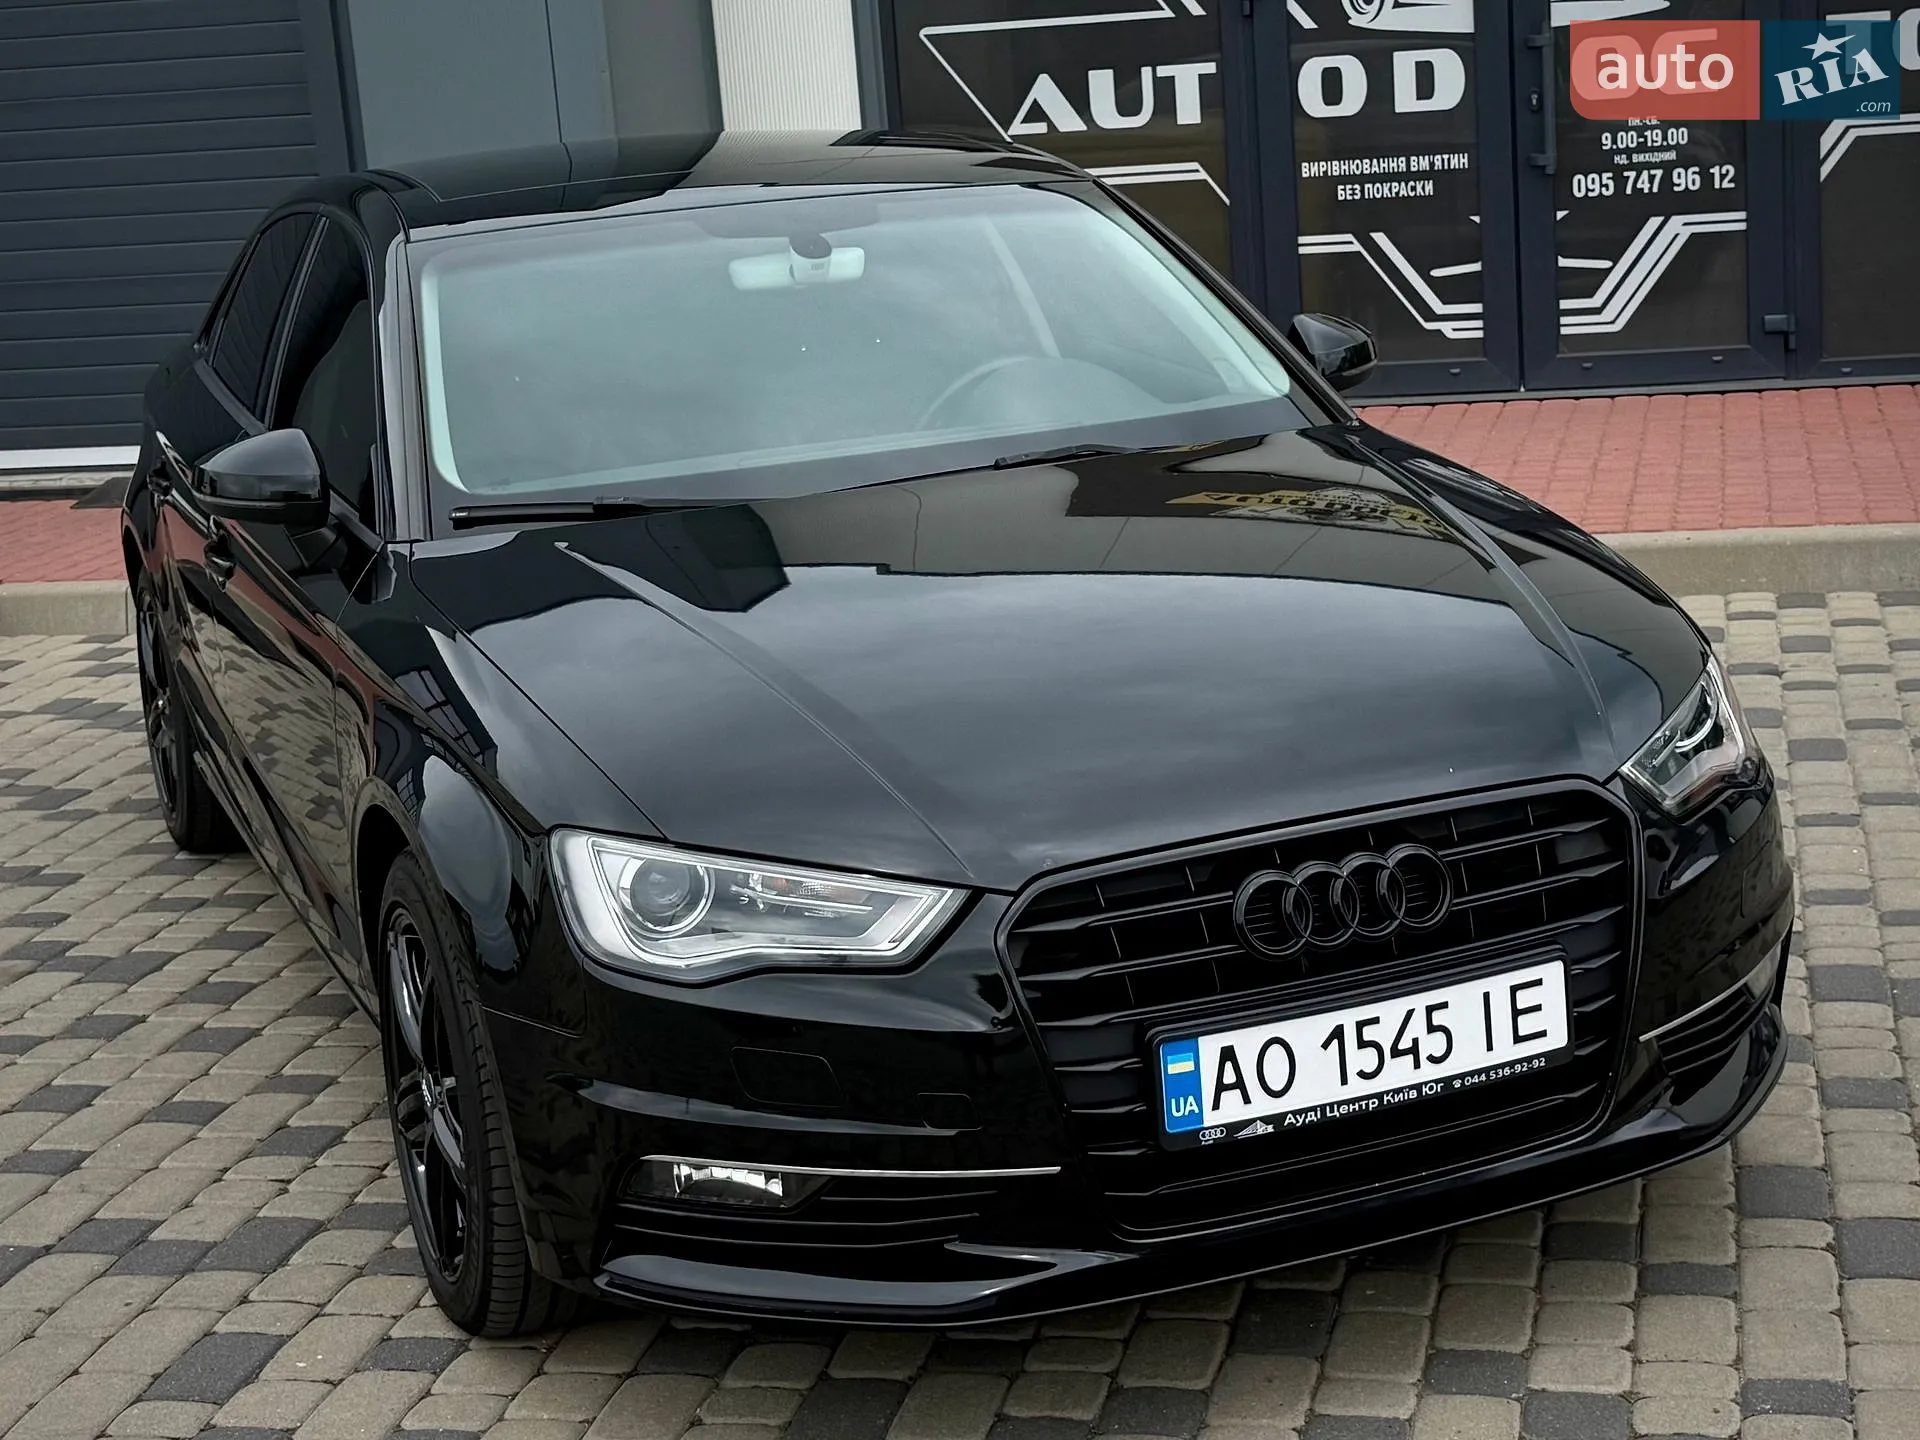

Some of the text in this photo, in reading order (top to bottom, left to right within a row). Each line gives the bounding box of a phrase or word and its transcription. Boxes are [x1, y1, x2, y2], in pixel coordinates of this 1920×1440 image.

[1601, 127, 1689, 150] 9.00-19.00
[1301, 153, 1469, 178] ВИРІВНЮВАННЯ ВМ'ЯТИН
[1613, 150, 1677, 165] НД. ВИХІДНИЙ
[1337, 180, 1434, 200] БЕЗ ПОКРАСКИ
[1572, 164, 1736, 198] 095 747 96 12
[1211, 977, 1548, 1112] AO 1545 IE
[1284, 1057, 1547, 1127] Ауді Центр Київ Юг 044 536-92-92
[1171, 1095, 1200, 1118] UA
